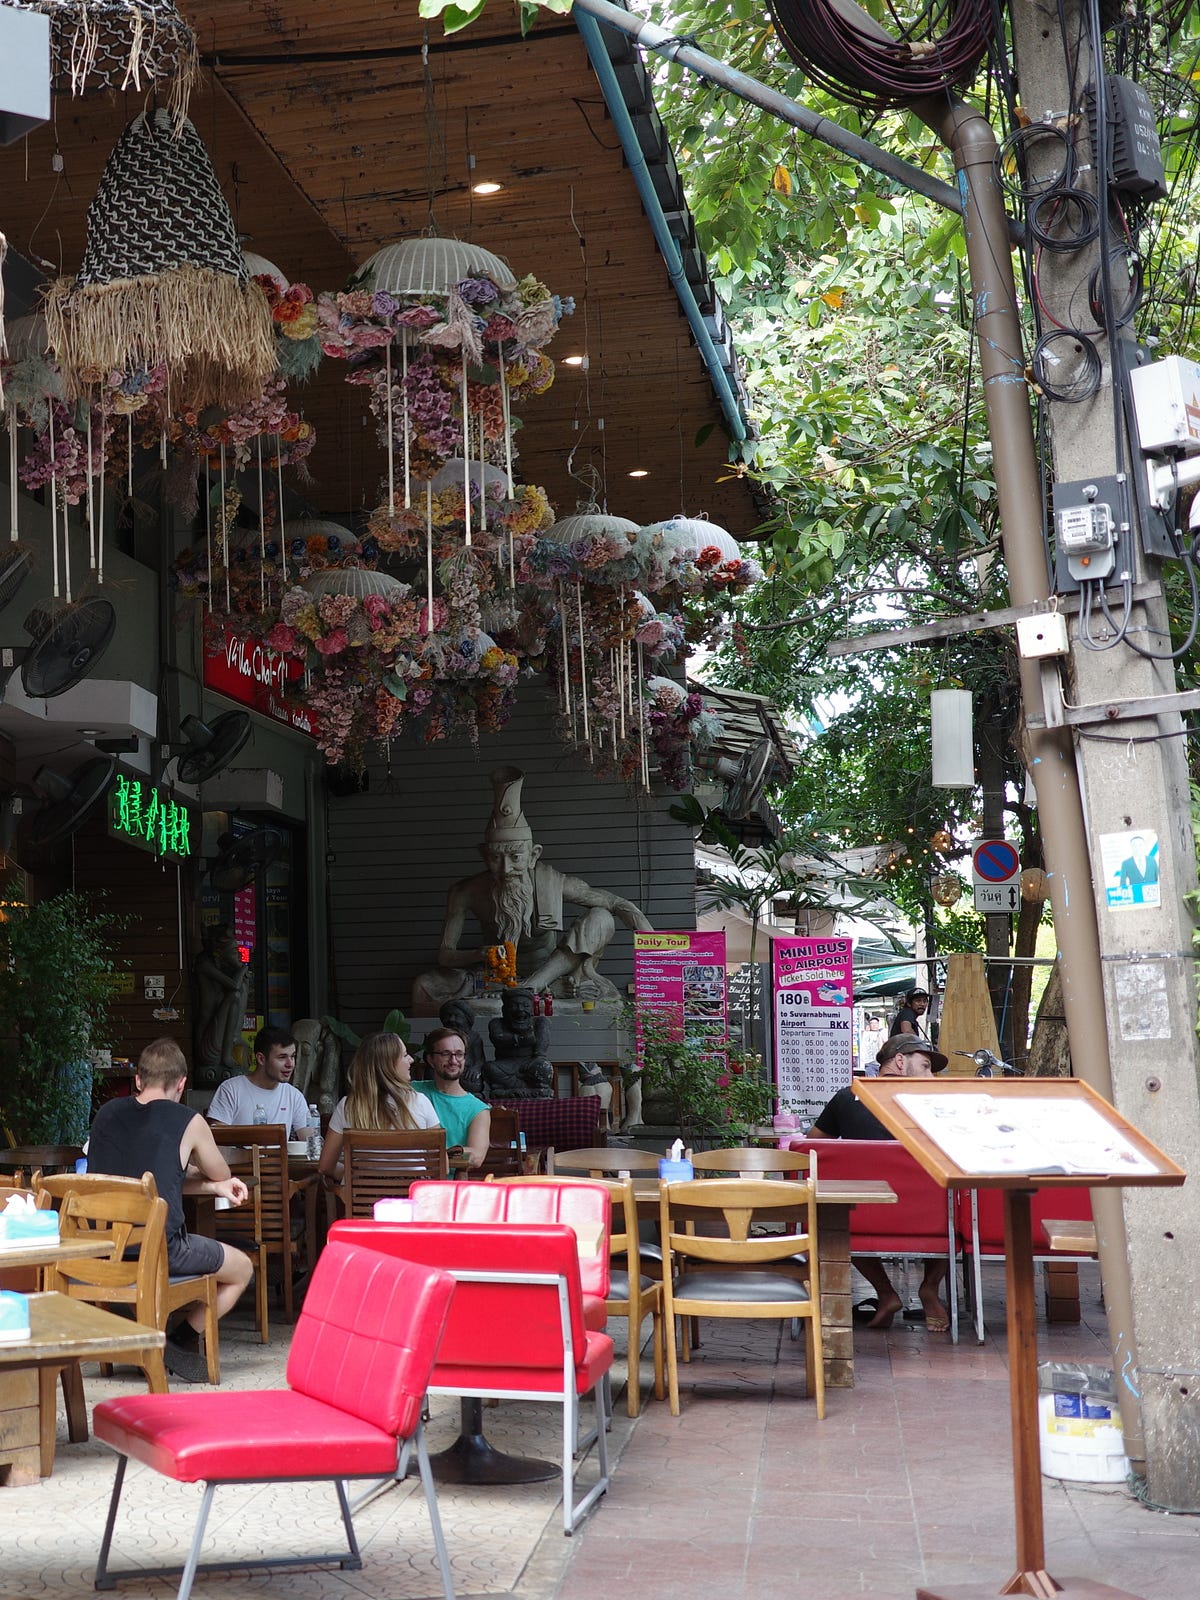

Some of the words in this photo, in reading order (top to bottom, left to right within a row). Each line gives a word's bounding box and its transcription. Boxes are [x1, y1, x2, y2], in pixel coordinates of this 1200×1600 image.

[225, 636, 252, 677] Villa
[980, 889, 1002, 905] วันคู่
[637, 938, 662, 946] Daily
[666, 938, 687, 946] Tour
[779, 946, 812, 959] MINI
[816, 942, 847, 954] BUS
[795, 955, 849, 970] AIRPORT
[780, 974, 805, 984] Ticket
[805, 971, 824, 981] Sold
[826, 970, 845, 978] here
[780, 1020, 806, 1028] Airport
[830, 1021, 850, 1029] BKK
